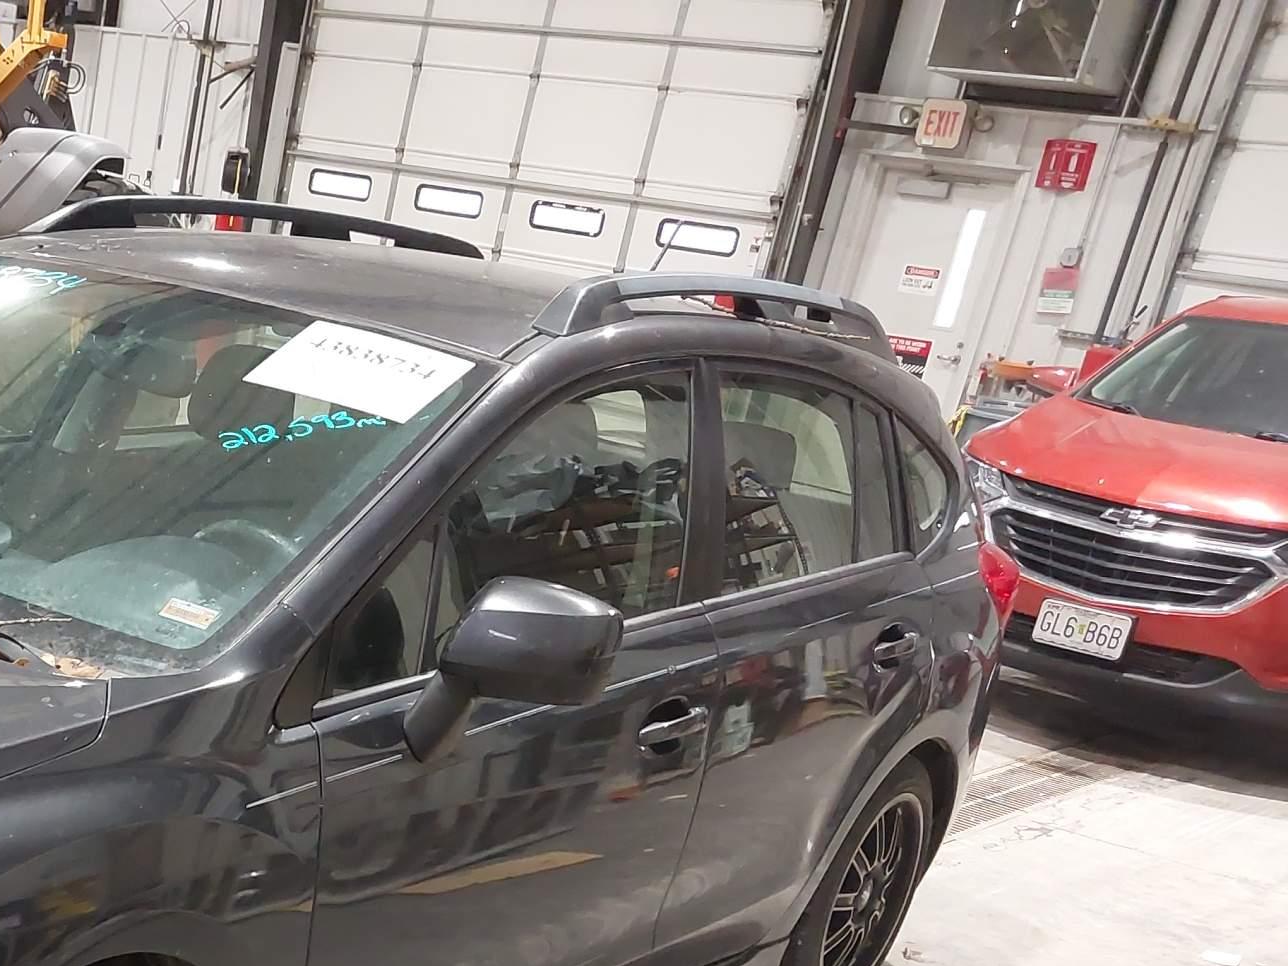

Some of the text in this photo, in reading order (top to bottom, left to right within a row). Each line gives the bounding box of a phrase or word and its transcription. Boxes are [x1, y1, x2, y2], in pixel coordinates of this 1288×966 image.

[924, 109, 961, 137] EXIT
[1040, 610, 1078, 638] GL6
[1083, 621, 1123, 649] B6B
